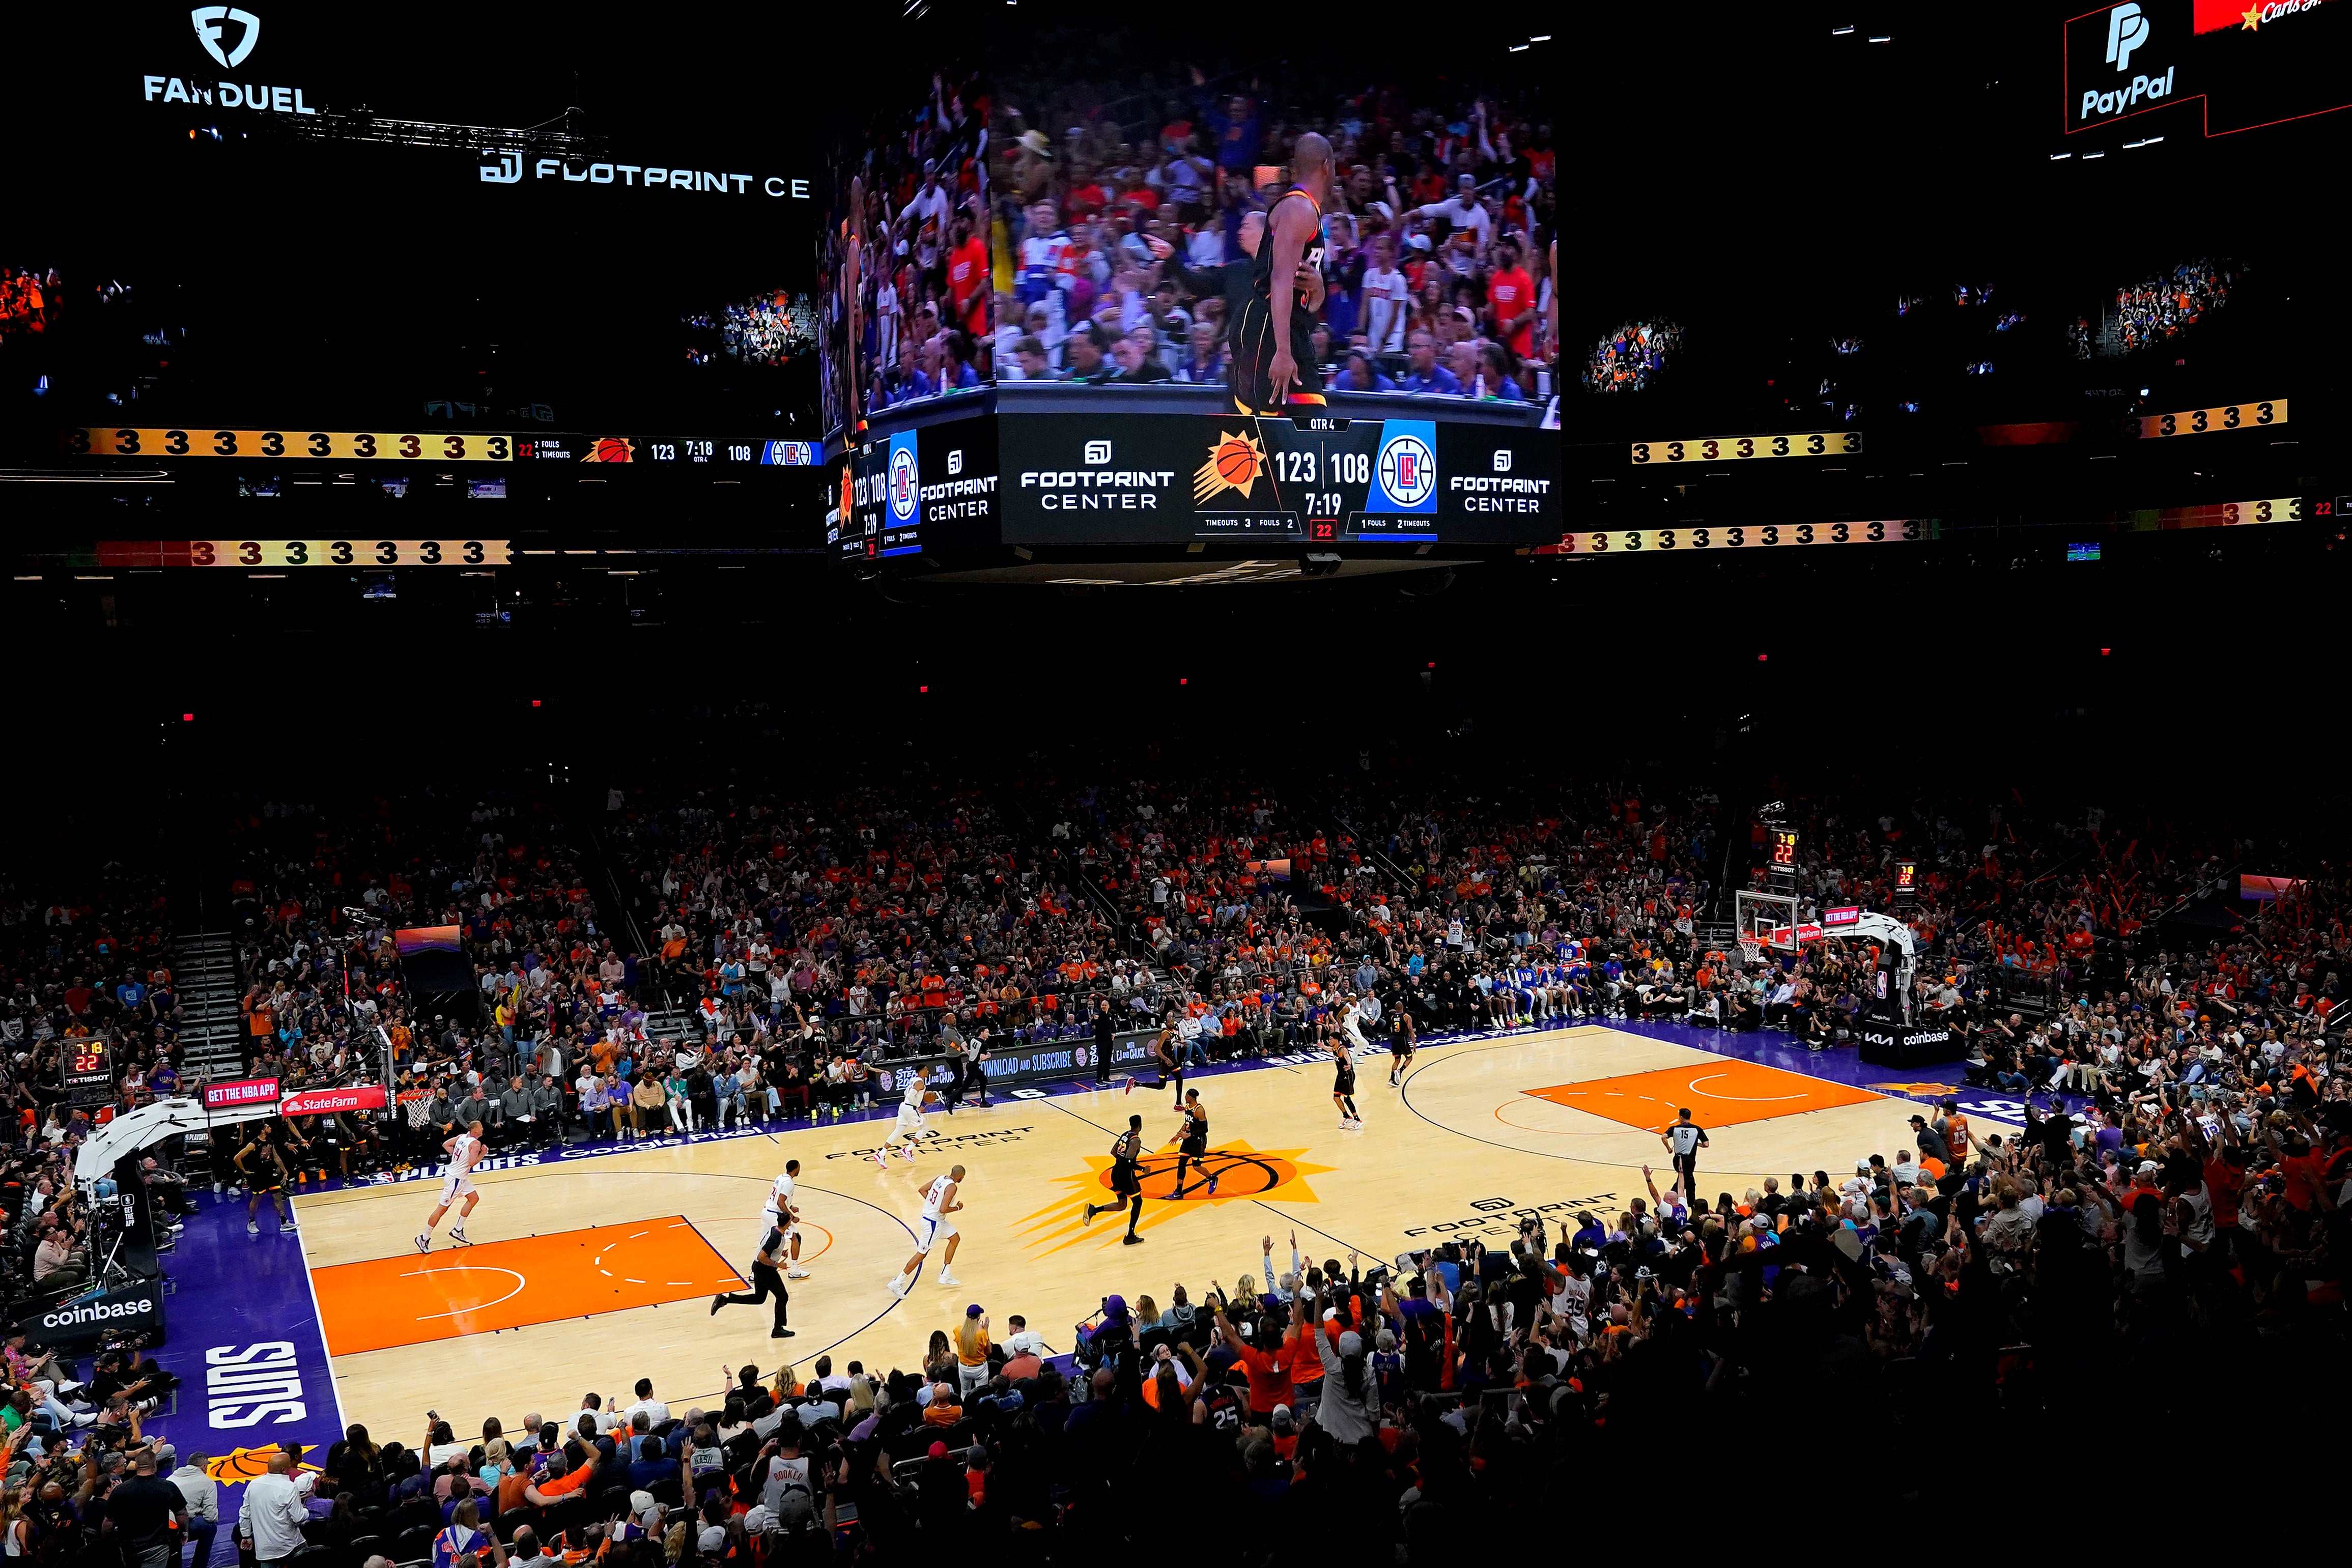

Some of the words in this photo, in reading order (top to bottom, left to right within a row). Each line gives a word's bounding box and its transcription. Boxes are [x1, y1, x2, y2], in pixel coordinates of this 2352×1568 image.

[144, 75, 315, 115] FANDUEL
[2082, 66, 2174, 119] PayPal
[536, 159, 753, 194] FOOTPRINT
[1311, 418, 1326, 430] QTR
[1329, 419, 1335, 430] 4
[2160, 415, 2176, 435] 3
[2192, 411, 2207, 432] 3
[2224, 407, 2240, 428] 3
[2256, 403, 2274, 424] 3
[115, 430, 140, 454] 3
[165, 431, 189, 454] 3
[214, 431, 238, 455] 3
[261, 432, 285, 456] 3
[308, 433, 331, 457] 3
[354, 434, 377, 457] 3
[400, 435, 421, 458] 3
[444, 436, 465, 459] 3
[487, 437, 508, 460] 3
[519, 444, 532, 457] 22
[651, 444, 674, 460] 123
[686, 441, 713, 455] 7:18
[728, 446, 751, 461] 108
[1633, 444, 1650, 463] 3
[1667, 442, 1684, 461] 3
[1702, 441, 1719, 459] 3
[1737, 439, 1754, 458] 3
[1772, 437, 1789, 455] 3
[1807, 435, 1825, 454] 3
[1843, 433, 1861, 453] 3
[1276, 451, 1316, 482] 123
[1331, 452, 1369, 483] 108
[1021, 471, 1174, 487] FOOTPRINT
[1451, 476, 1550, 494] FOOTPRINT
[855, 477, 867, 506] 123
[871, 472, 886, 503] 108
[920, 476, 998, 501] FOOTPRINT
[1041, 494, 1157, 509] CENTER
[1306, 493, 1342, 515] 7:19
[1465, 497, 1539, 513] CENTER
[2316, 503, 2331, 515] 22
[929, 500, 988, 522] CENTER
[2223, 504, 2240, 525] 3
[2256, 501, 2272, 522] 3
[2289, 499, 2302, 520] 3
[864, 514, 876, 535] 7:19
[1244, 519, 1251, 528] 3
[1287, 519, 1293, 528] 2
[1317, 525, 1332, 537] 22
[1362, 519, 1366, 528] 1
[1397, 519, 1402, 528] 2
[1558, 534, 1575, 553] 3
[1592, 533, 1608, 551] 3
[1625, 532, 1641, 550] 3
[1659, 530, 1676, 549] 3
[1692, 529, 1710, 548] 3
[1727, 528, 1744, 546] 3
[1761, 526, 1778, 545] 3
[1796, 525, 1813, 544] 3
[1831, 523, 1849, 543] 3
[1867, 522, 1885, 541] 3
[191, 541, 215, 565] 3
[239, 542, 262, 565] 3
[286, 541, 308, 564] 3
[331, 541, 353, 564] 3
[376, 541, 398, 564] 3
[420, 541, 442, 564] 3
[463, 541, 485, 564] 3
[1779, 833, 1795, 845] 7:18
[1776, 844, 1793, 864] 22
[1900, 874, 1911, 885] 22
[1394, 1021, 1400, 1032] 3
[1904, 1031, 1949, 1045] coinbase
[77, 1042, 102, 1054] 7:18
[1116, 1050, 1122, 1061] EJ
[1129, 1047, 1146, 1060] CHUCK
[76, 1055, 97, 1071] 22
[979, 1057, 1018, 1077] OWNLOAD
[1020, 1060, 1031, 1071] AND
[1032, 1050, 1072, 1071] SUBSCRIBE
[78, 1075, 109, 1083] TISSOT
[895, 1069, 918, 1079] STEA
[931, 1075, 939, 1083] AND
[940, 1071, 955, 1084] CHUC
[208, 1089, 224, 1103] GET
[225, 1087, 241, 1100] THE
[242, 1085, 259, 1098] NBA
[260, 1083, 275, 1097] APP
[1011, 1089, 1047, 1099] 6
[560, 1138, 683, 1159] Google
[689, 1127, 763, 1142] Pixel
[1681, 1130, 1689, 1139] 15
[1953, 1130, 1967, 1145] 13
[1117, 1140, 1126, 1157] 22
[400, 1153, 540, 1182] PLAOFFS
[929, 1188, 938, 1205] 33
[1404, 1193, 1618, 1237] FOOTPRINT
[1453, 1206, 1623, 1240] CETER
[43, 1299, 152, 1327] coinbase
[1566, 1298, 1584, 1317] 35
[206, 1341, 307, 1429] SUNS
[1214, 1406, 1238, 1430] 25
[694, 1454, 713, 1465] NASH
[774, 1468, 803, 1481] BOOKER
